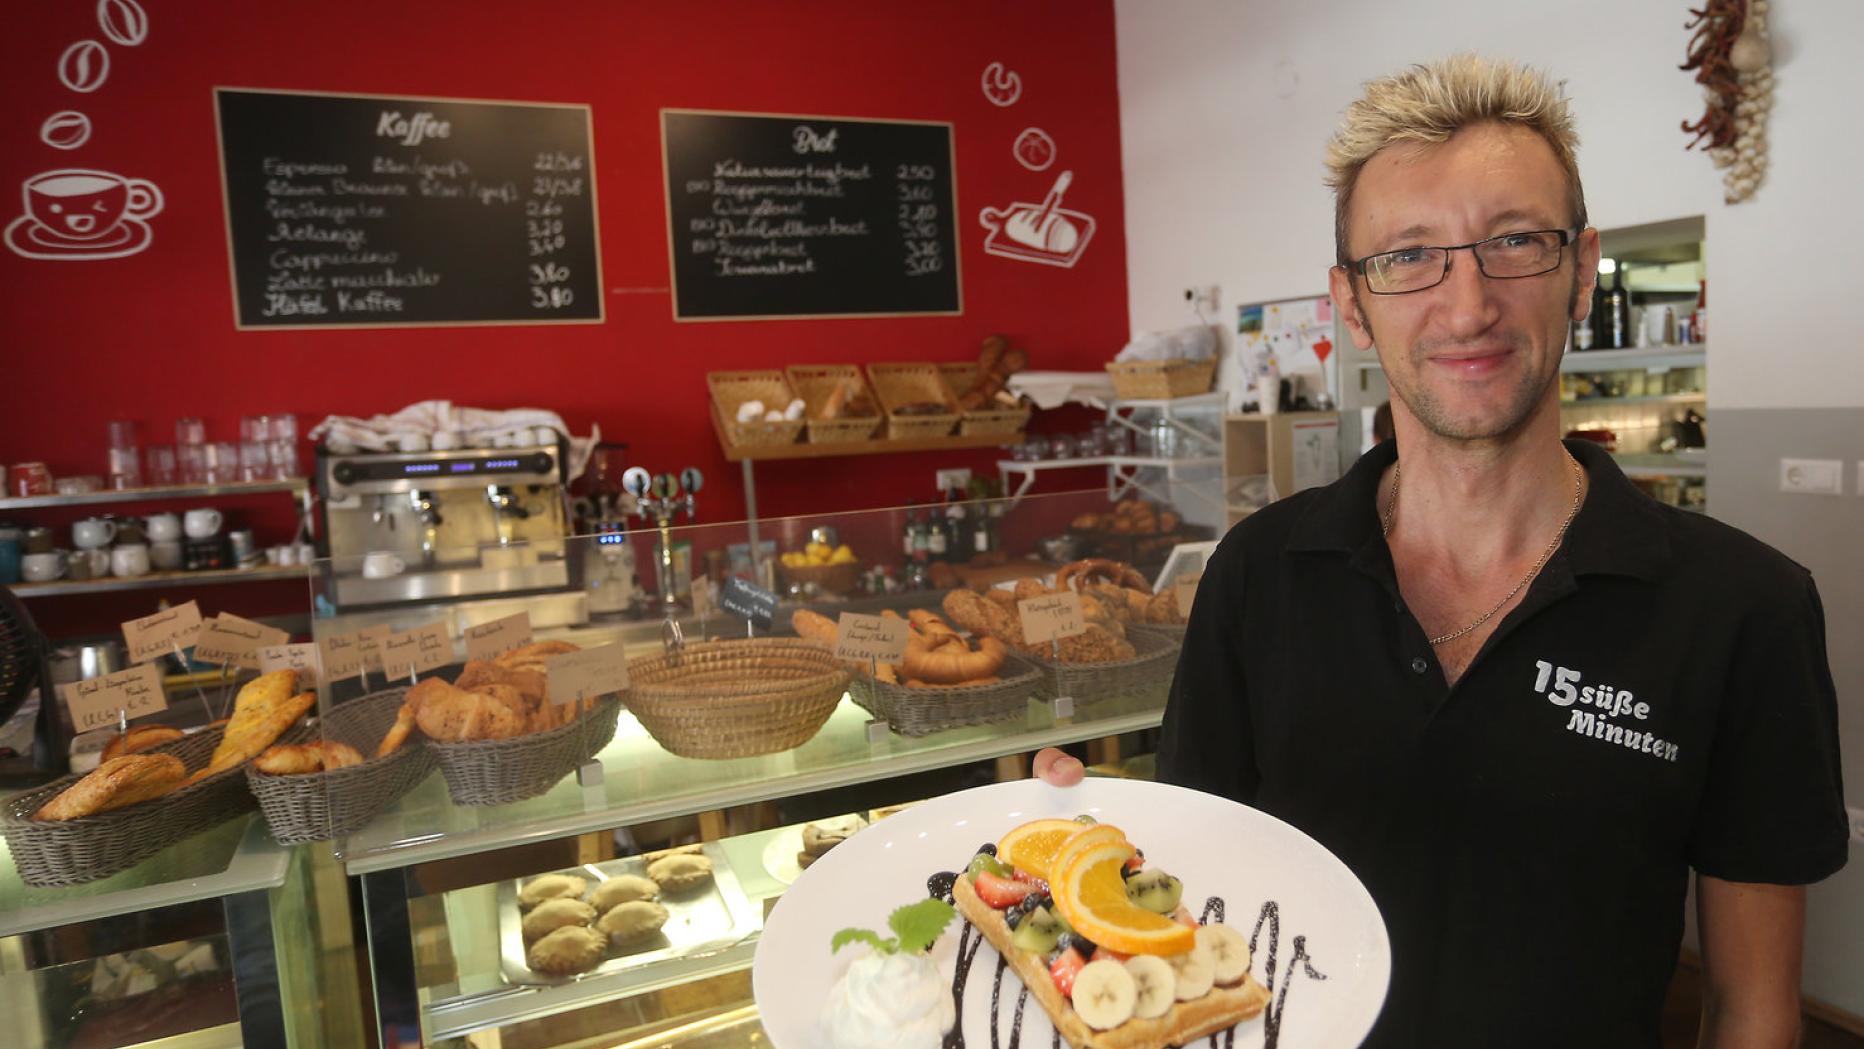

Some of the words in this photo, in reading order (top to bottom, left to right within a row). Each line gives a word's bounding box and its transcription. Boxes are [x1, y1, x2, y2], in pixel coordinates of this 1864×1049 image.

[376, 111, 450, 146] Kaffee
[267, 222, 365, 250] Melange
[268, 248, 398, 270] Cappuccino
[337, 290, 402, 312] Kaffee
[1535, 660, 1581, 706] 15
[1579, 684, 1650, 720] süße
[1566, 709, 1679, 762] Minuten
